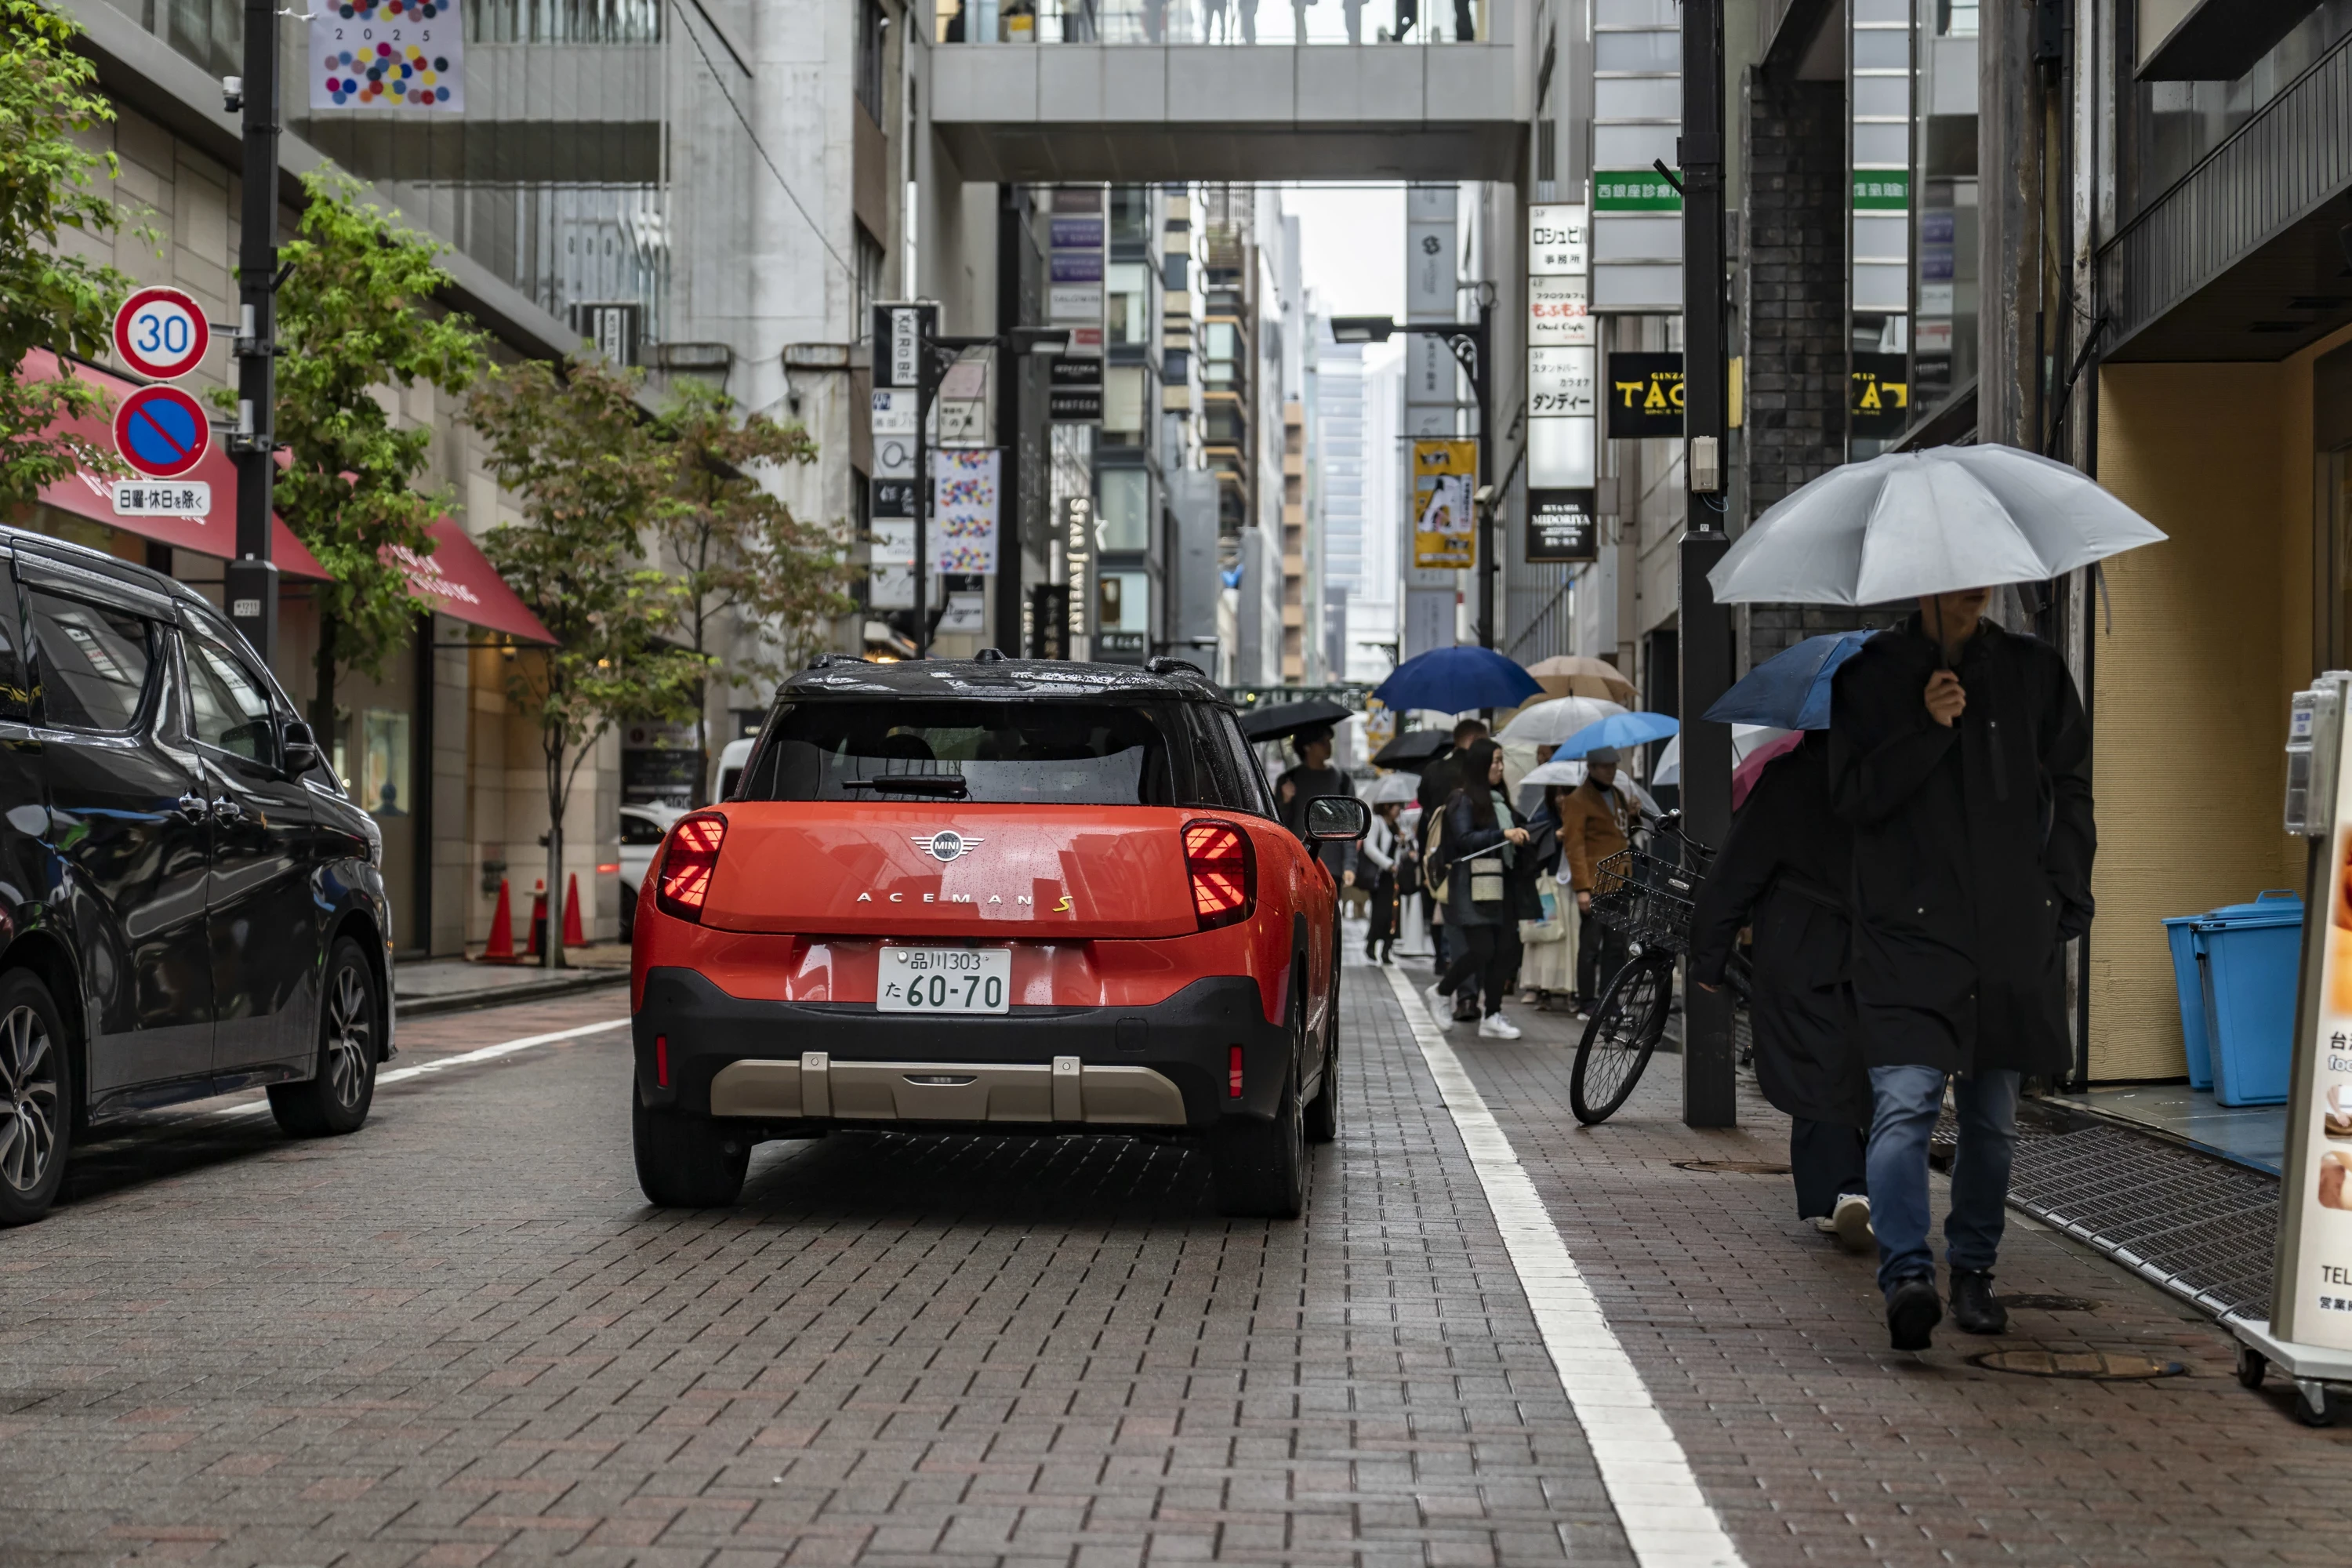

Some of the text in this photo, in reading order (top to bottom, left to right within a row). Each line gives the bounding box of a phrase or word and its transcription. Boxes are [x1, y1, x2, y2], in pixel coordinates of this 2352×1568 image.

[1544, 255, 1581, 264] 事務所
[1531, 302, 1586, 318] もふもふ
[137, 314, 188, 351] 30
[1534, 393, 1590, 409] ダンディー
[120, 489, 201, 509] 日曜・休日を除く
[1531, 514, 1591, 526] MIDORIYA
[1066, 498, 1091, 633] STAR JEWELRY
[934, 841, 960, 851] MINI
[856, 892, 1073, 913] ACEMAN S
[885, 975, 1002, 1008] た 60-70
[2330, 1031, 2352, 1051] 台
[2321, 1265, 2352, 1286] TEL
